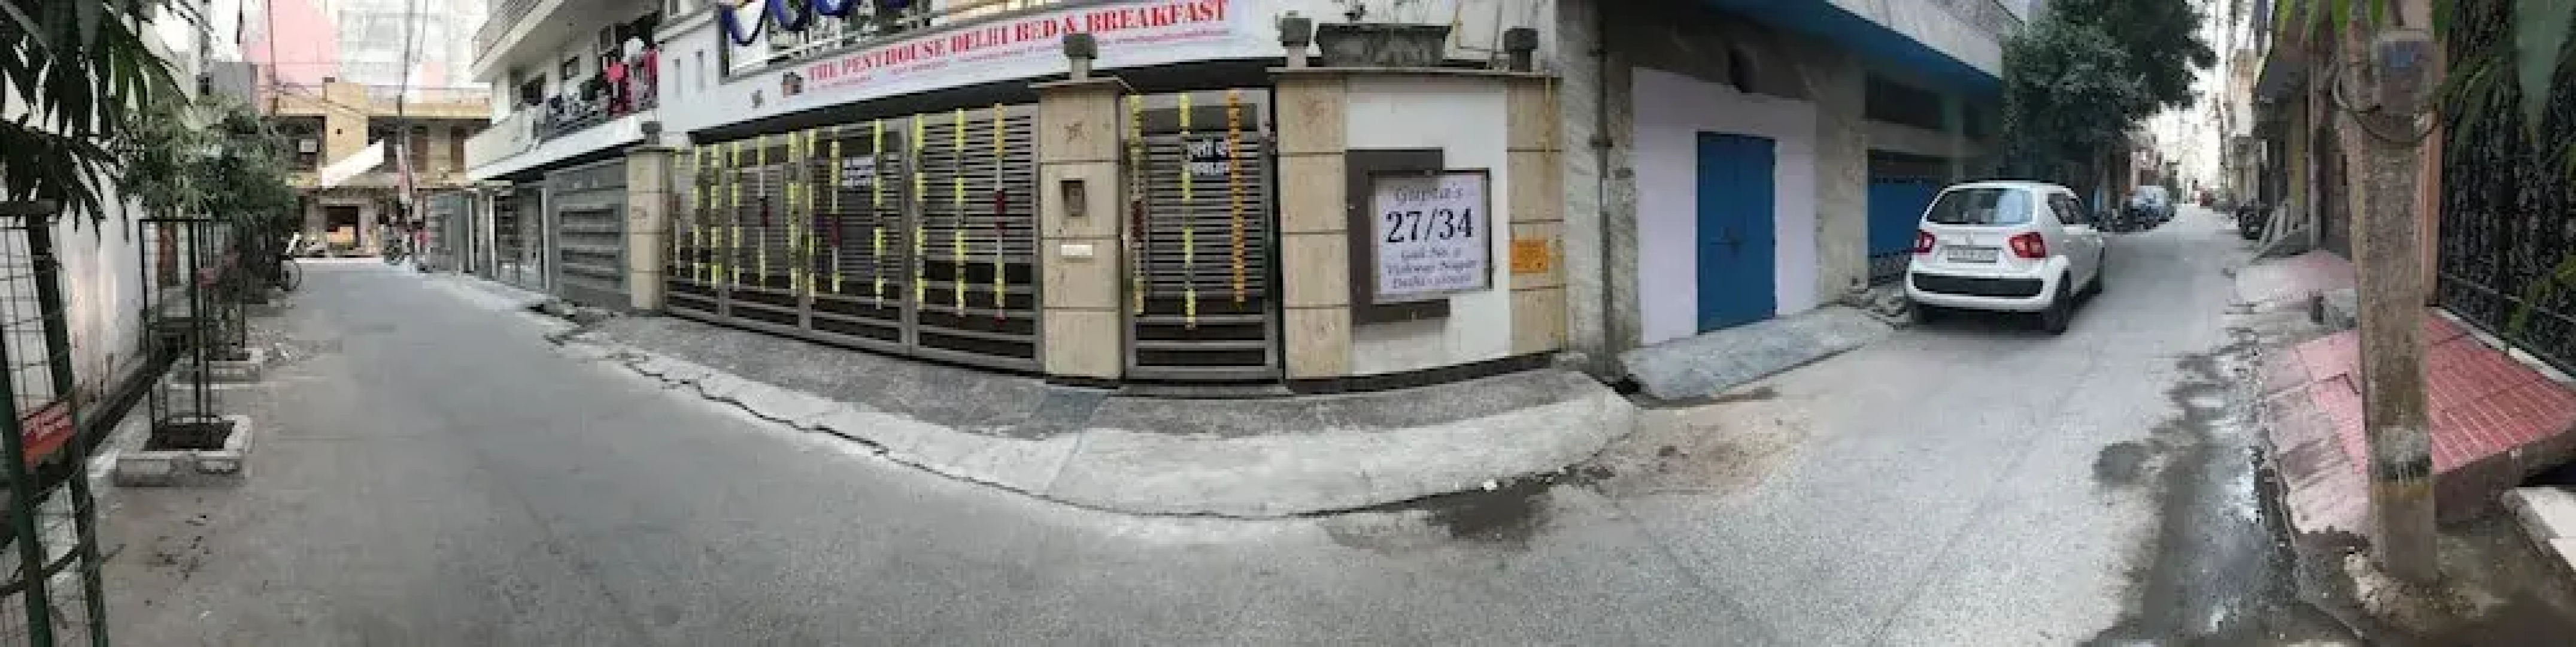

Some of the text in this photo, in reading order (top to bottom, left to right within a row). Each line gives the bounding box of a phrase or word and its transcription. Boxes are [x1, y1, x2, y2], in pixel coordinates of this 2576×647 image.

[809, 64, 838, 81] THE
[842, 40, 946, 75] PENTHOUSE
[951, 27, 1009, 53] DELHI
[1016, 20, 1058, 41] BED
[1086, 0, 1228, 32] BREAKFAST
[1386, 208, 1473, 243] 27/34
